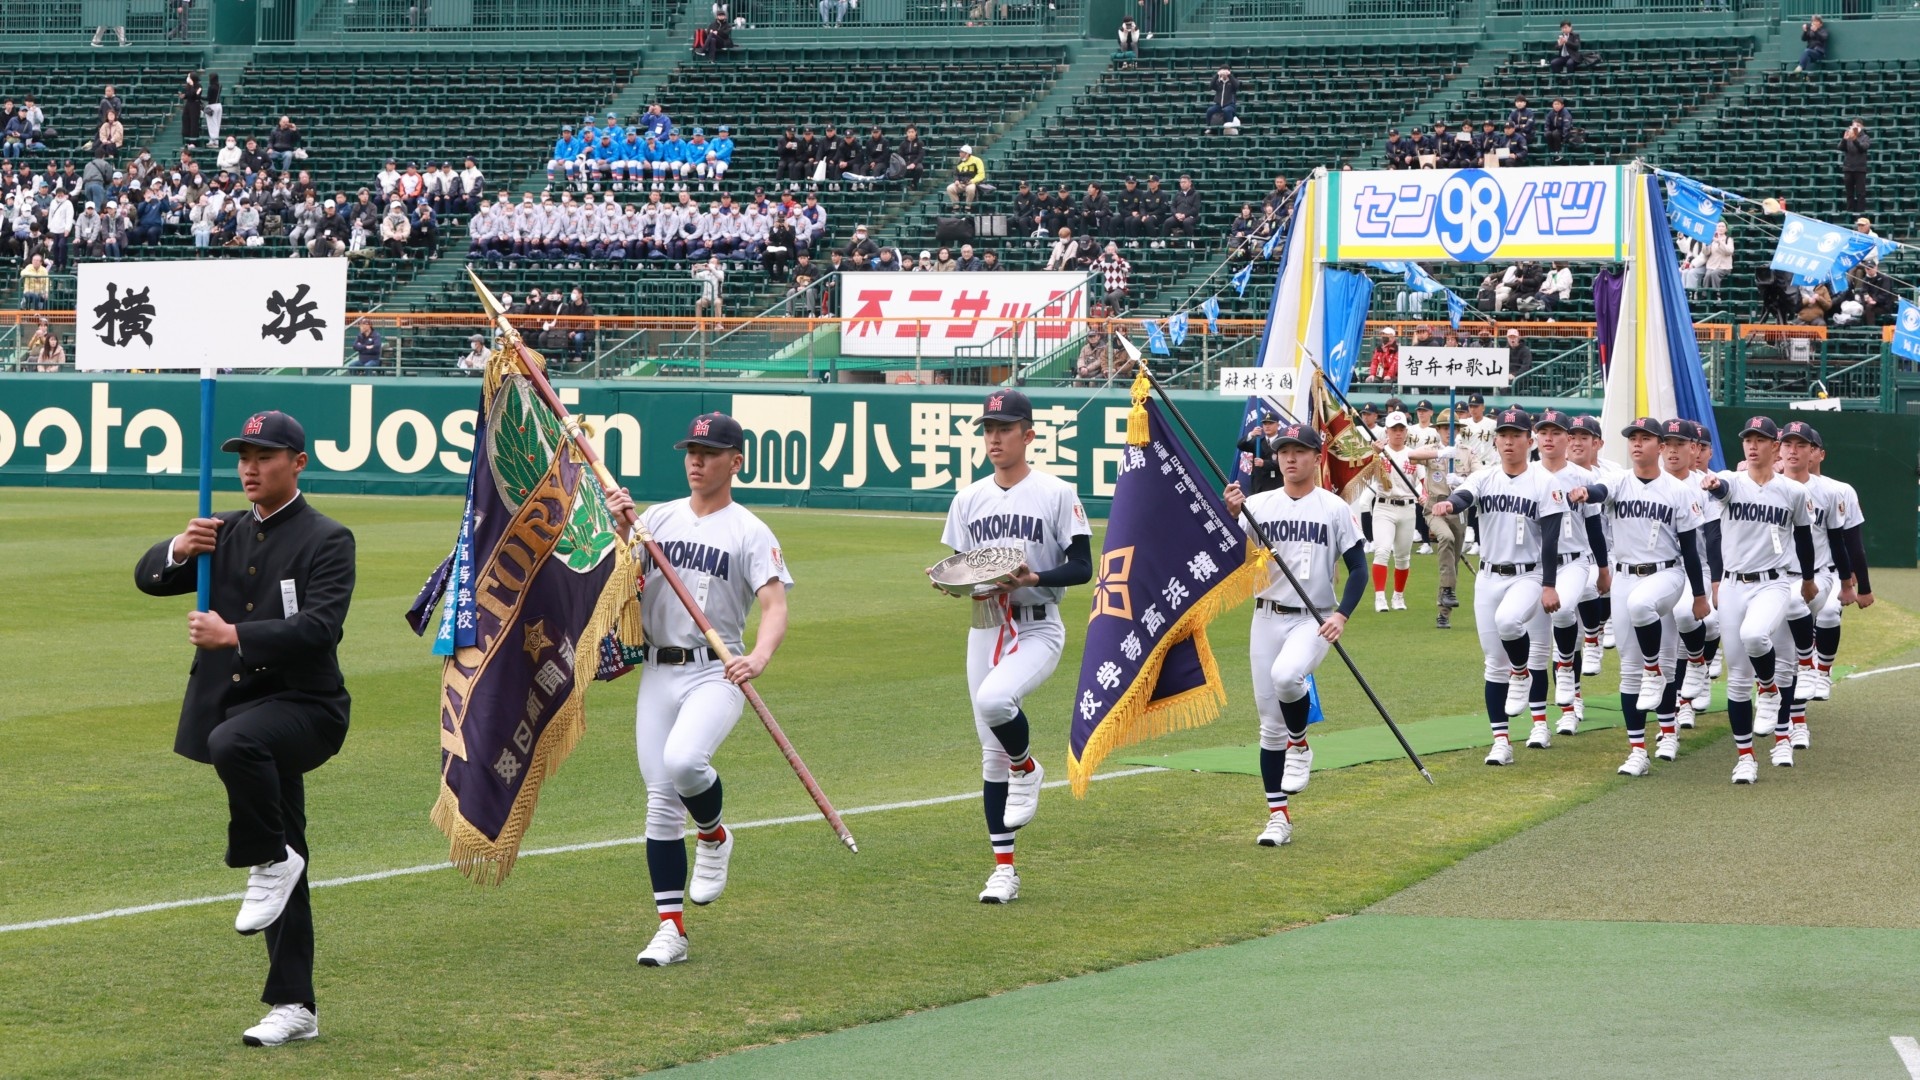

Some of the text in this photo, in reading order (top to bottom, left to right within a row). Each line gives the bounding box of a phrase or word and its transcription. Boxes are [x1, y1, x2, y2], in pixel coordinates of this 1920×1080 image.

[91, 281, 328, 349] 横浜
[846, 290, 1082, 339] 不二サッシ
[1405, 355, 1503, 377] 智弁和歌山
[1224, 372, 1293, 390] 神村学園
[314, 384, 641, 476] Josn
[1479, 494, 1538, 520] YOKOHAMA
[1614, 500, 1674, 526] YOKOHAMA
[1728, 502, 1789, 528] YOKOHAMA
[968, 514, 1044, 547] YOKOHAMA
[1079, 550, 1219, 720] 横浜高等学校
